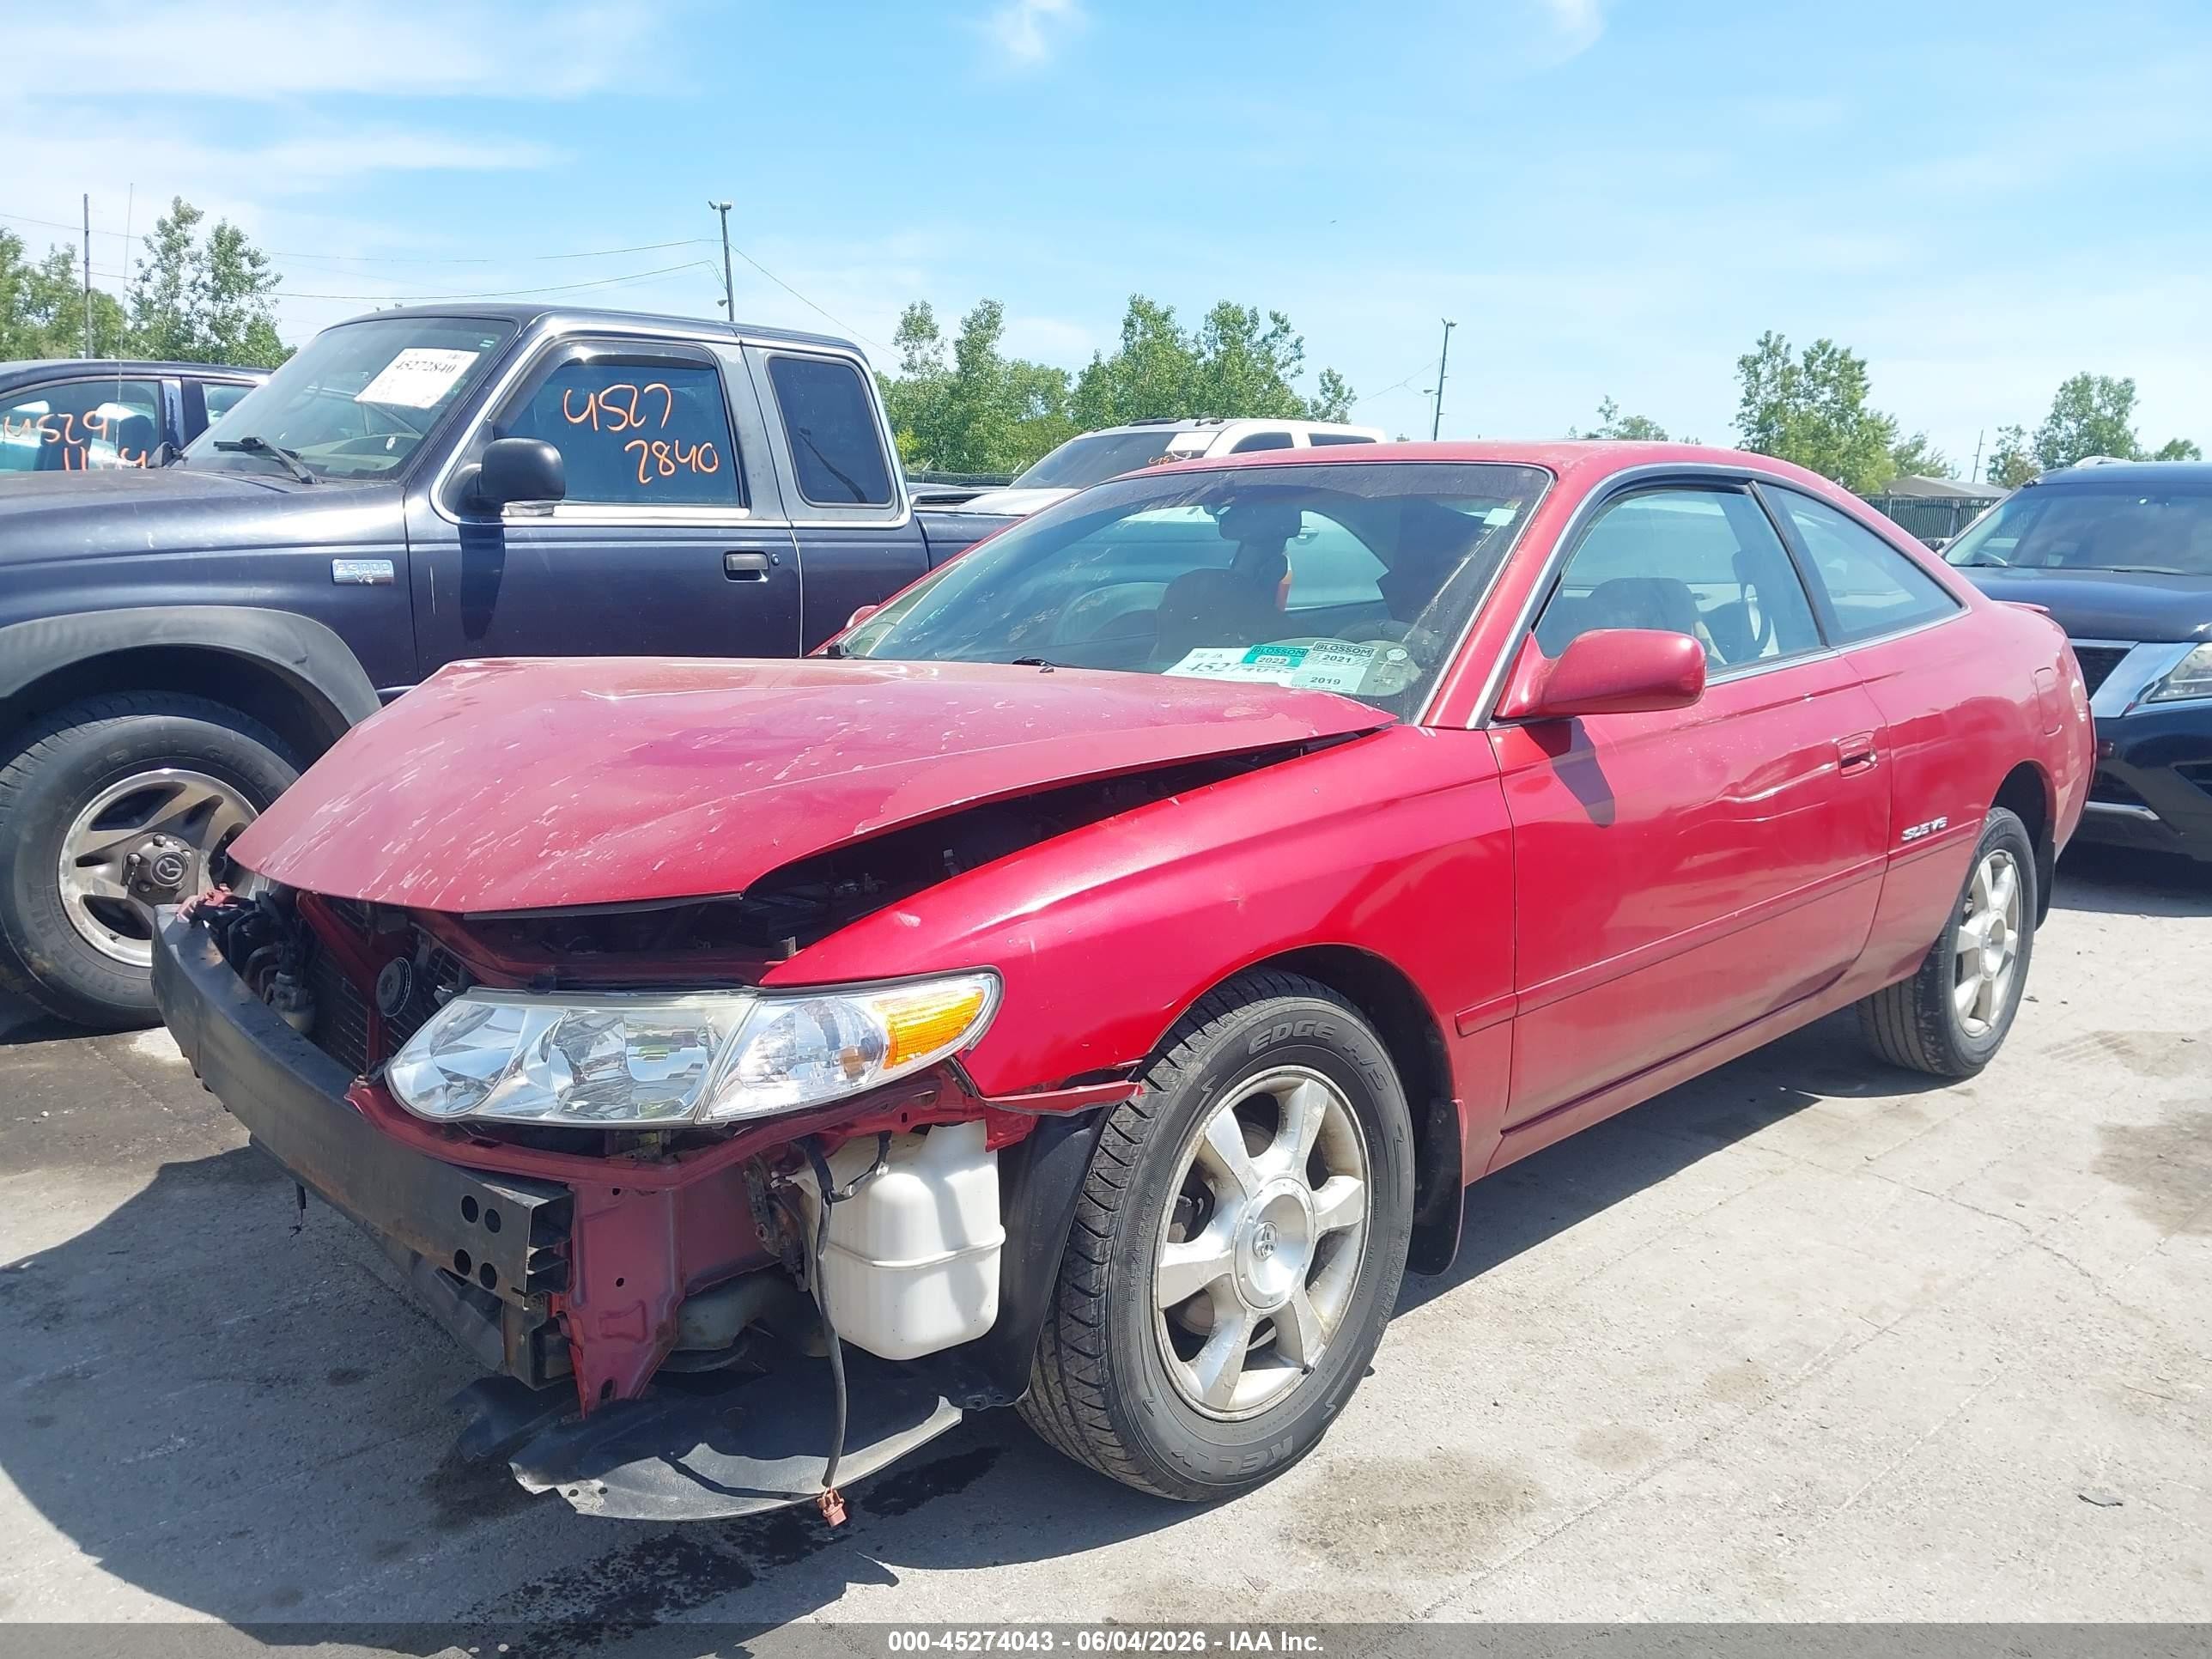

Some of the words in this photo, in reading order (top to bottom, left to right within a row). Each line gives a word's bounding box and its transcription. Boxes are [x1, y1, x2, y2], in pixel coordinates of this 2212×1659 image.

[395, 361, 458, 374] 45272840
[563, 383, 672, 431] 4527
[3, 412, 108, 445] 4529
[624, 439, 719, 484] 2840
[1254, 646, 1306, 658] BLOSSOM
[1316, 643, 1372, 657] BLOSSOM
[1257, 656, 1287, 665] 2022
[1322, 654, 1352, 664] 2021
[1310, 676, 1341, 685] 2019
[1249, 1019, 1337, 1055] EDGE
[1170, 1435, 1293, 1478] KELLY
